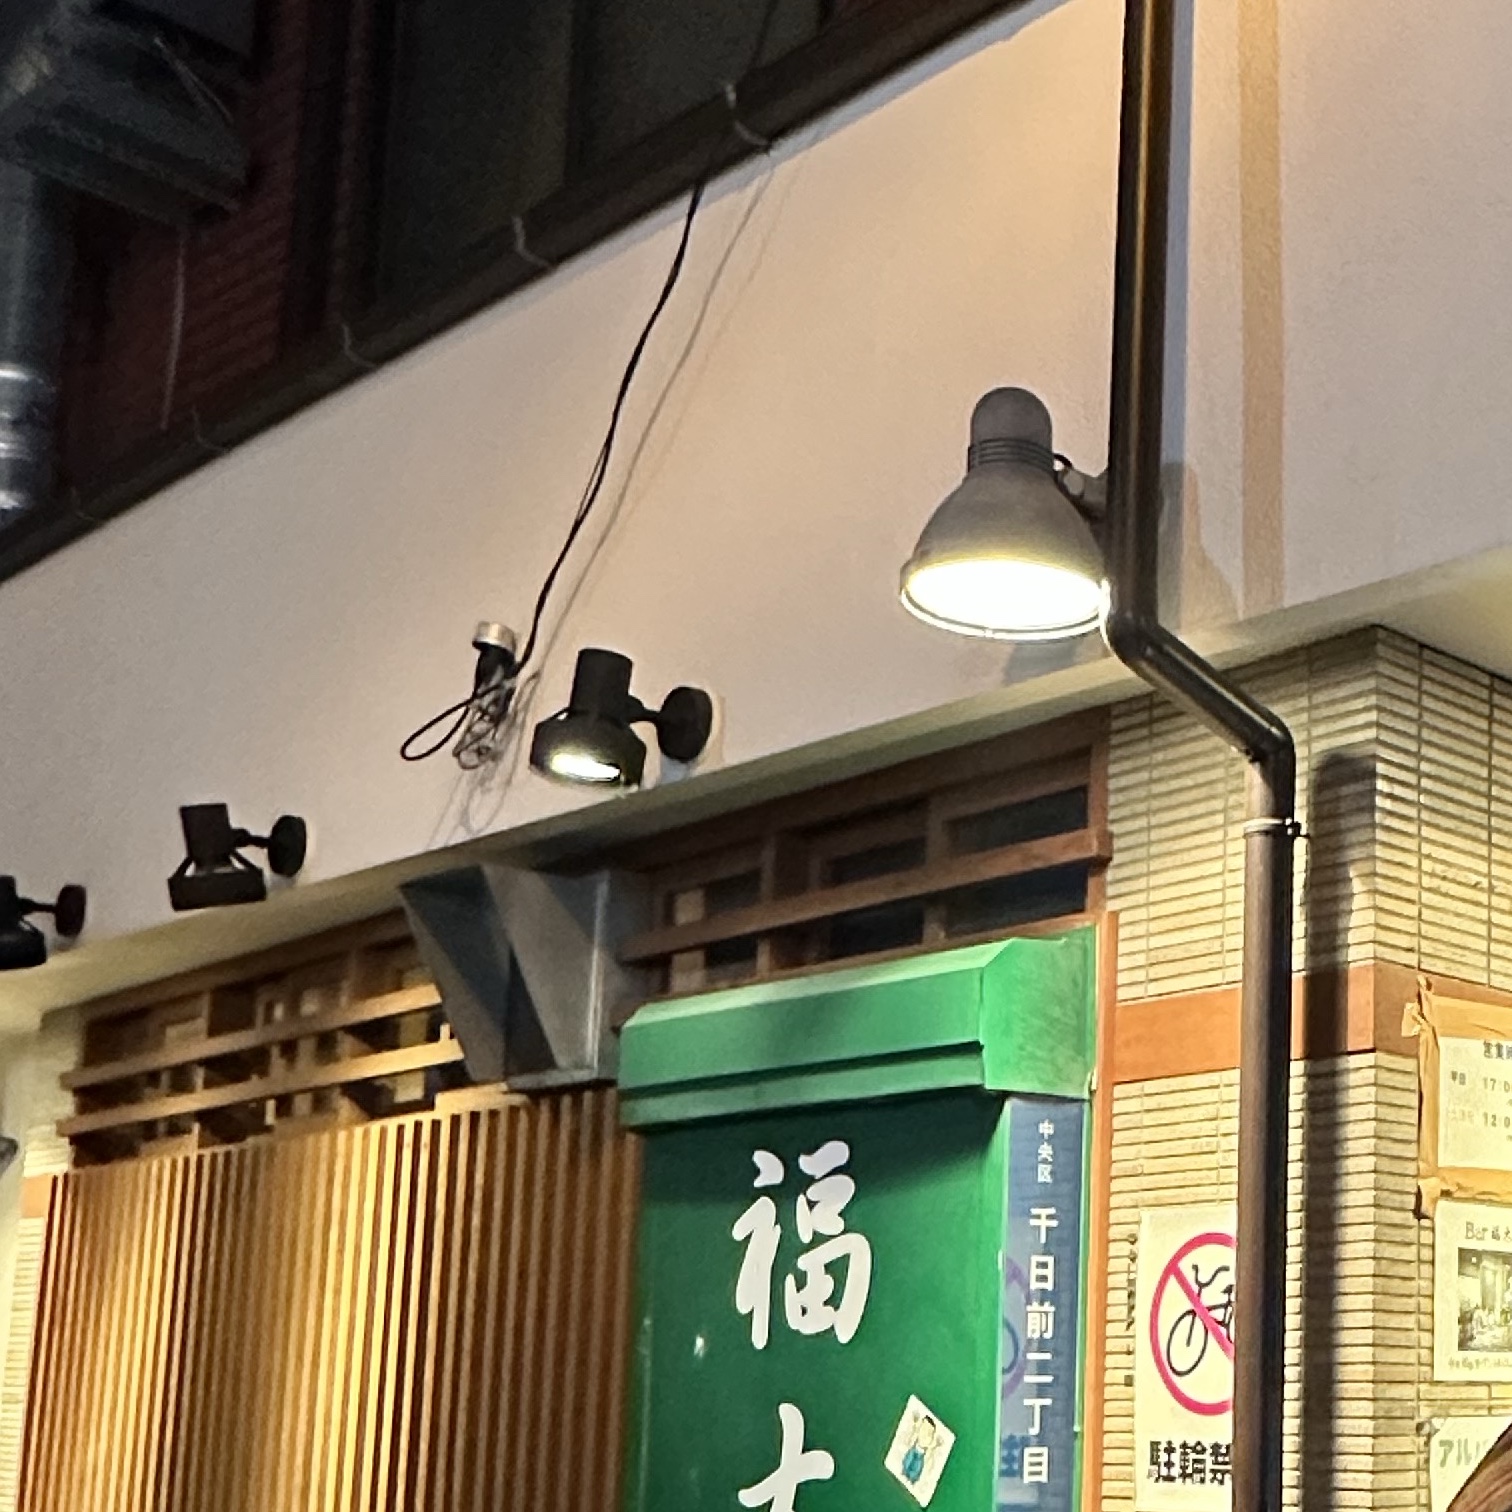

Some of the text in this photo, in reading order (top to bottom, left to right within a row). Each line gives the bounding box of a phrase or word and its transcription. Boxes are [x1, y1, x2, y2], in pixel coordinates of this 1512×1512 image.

[1037, 1119, 1055, 1184] 中央区
[1022, 1206, 1060, 1484] 千日前二丁目
